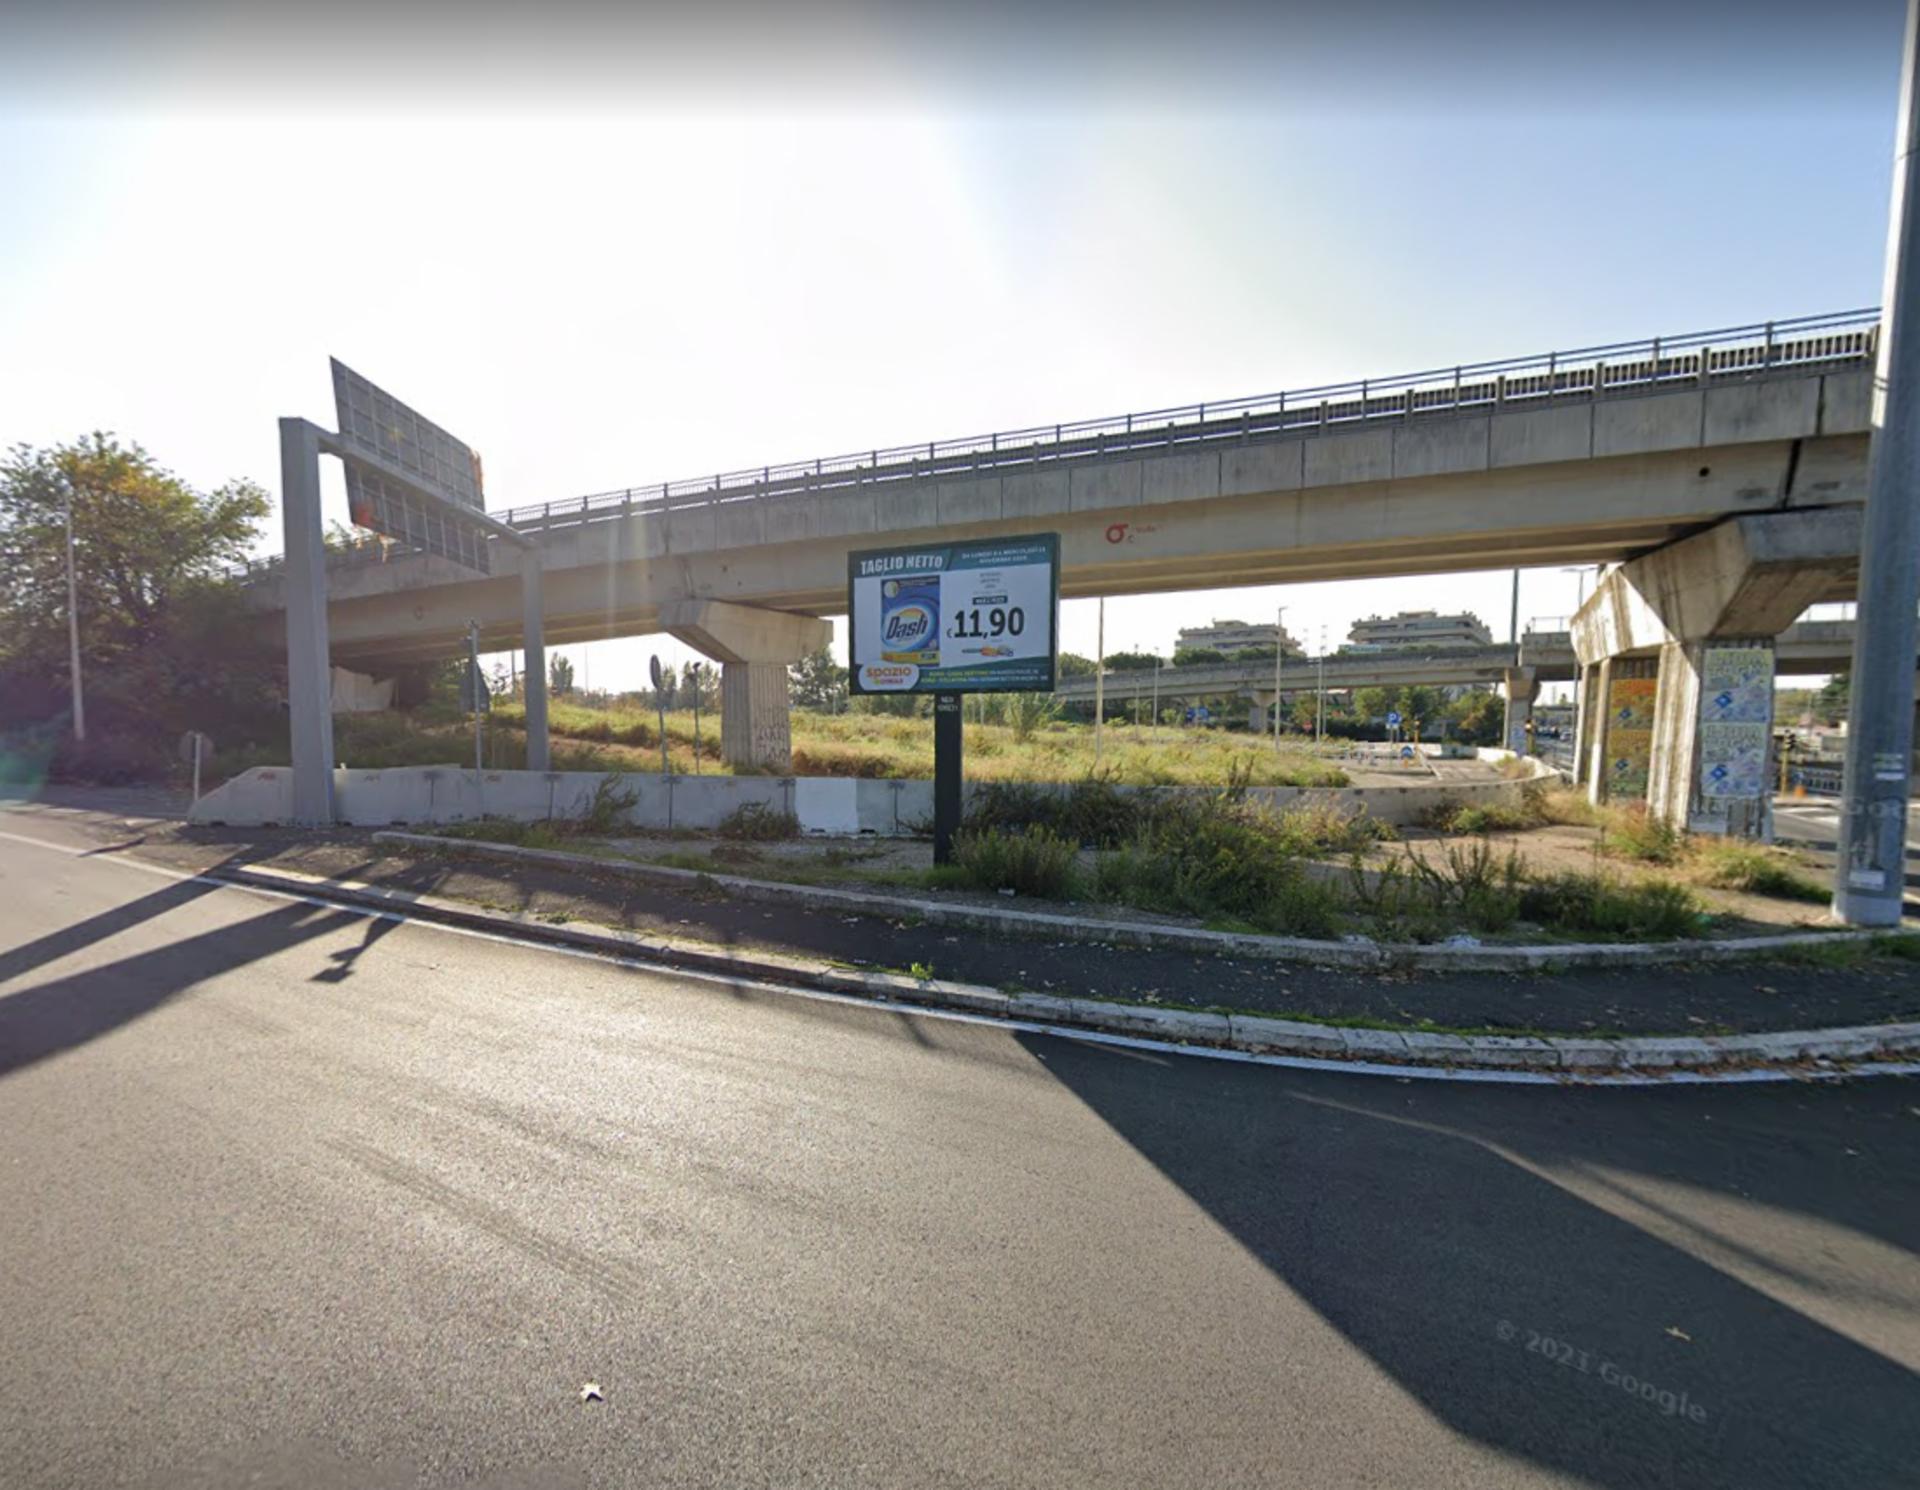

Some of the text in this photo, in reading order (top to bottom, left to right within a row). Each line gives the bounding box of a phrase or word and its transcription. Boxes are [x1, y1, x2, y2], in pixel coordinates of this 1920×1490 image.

[860, 555, 943, 576] TAGLIO NETTO
[886, 612, 928, 640] Dash
[865, 666, 912, 679] spazio
